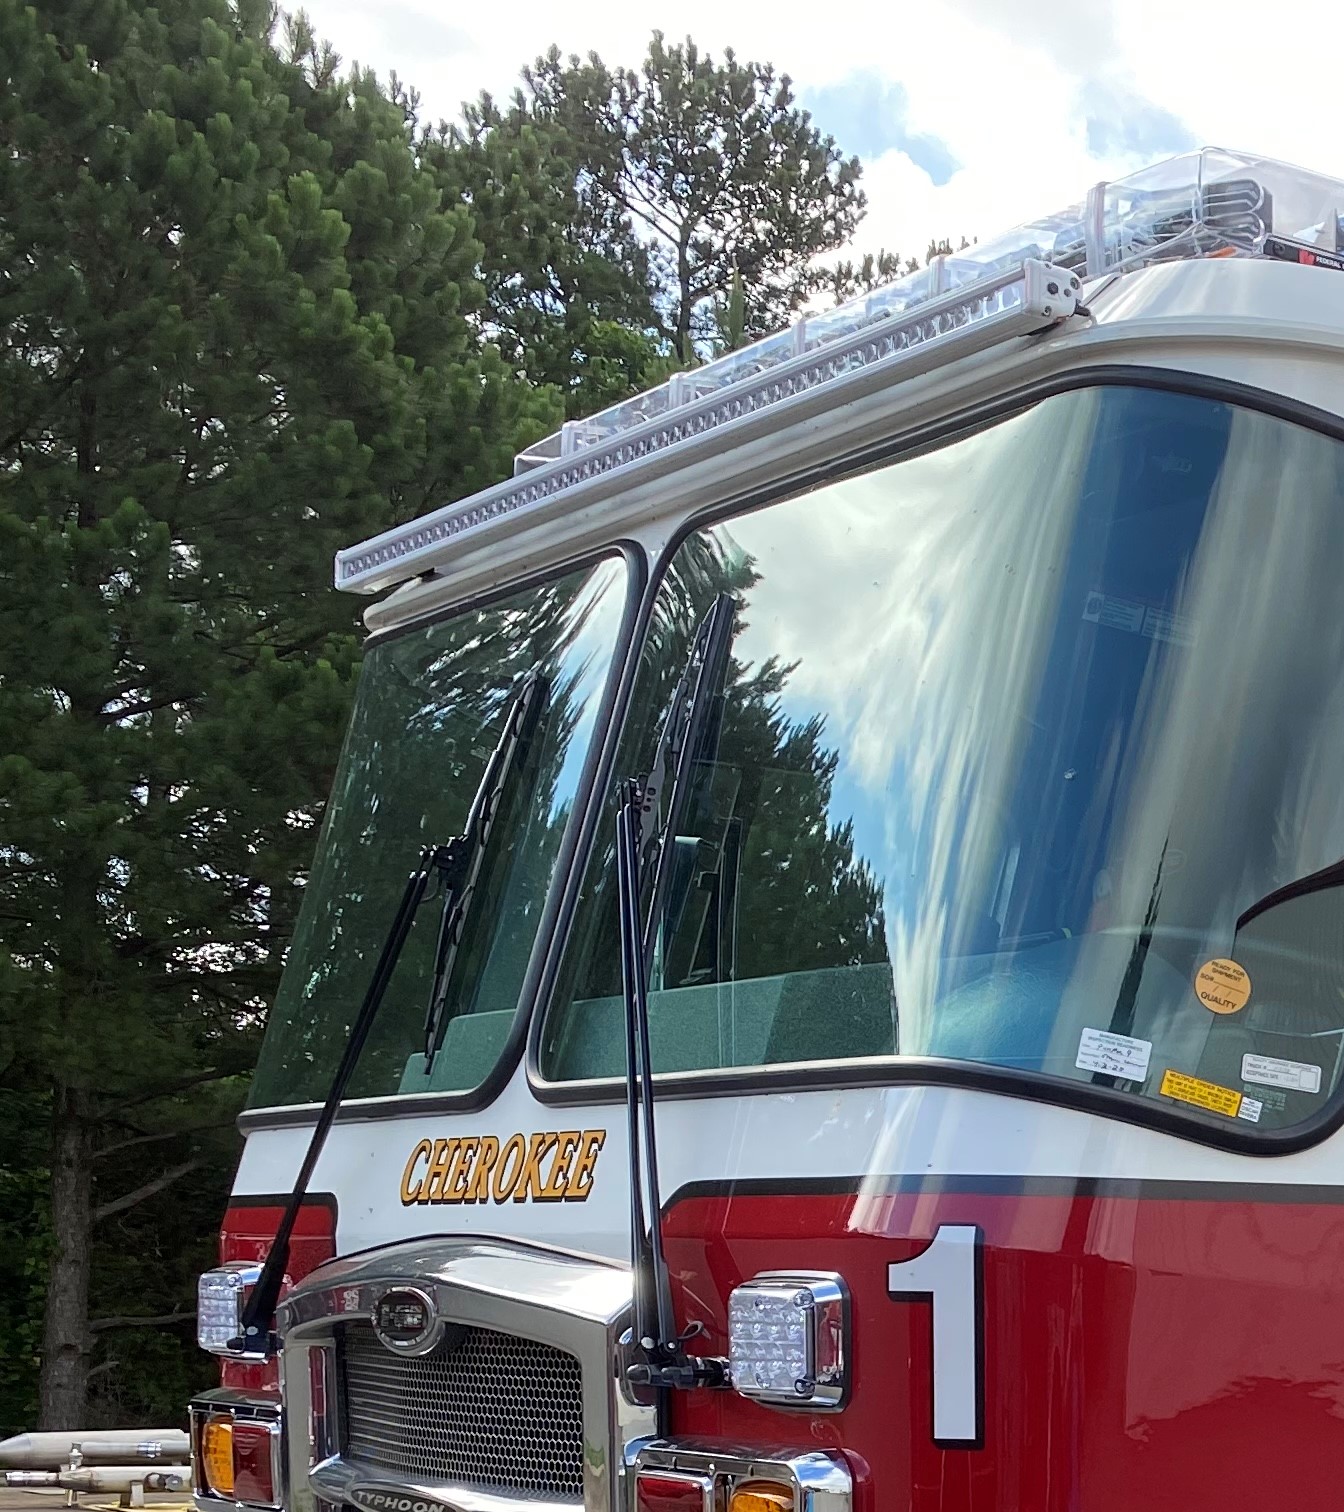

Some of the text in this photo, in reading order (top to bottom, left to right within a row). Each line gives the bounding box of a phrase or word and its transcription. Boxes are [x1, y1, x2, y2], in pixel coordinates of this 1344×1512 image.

[1201, 991, 1237, 1009] QUALITY
[401, 1129, 606, 1206] CHEROKEE
[887, 1223, 984, 1449] 1
